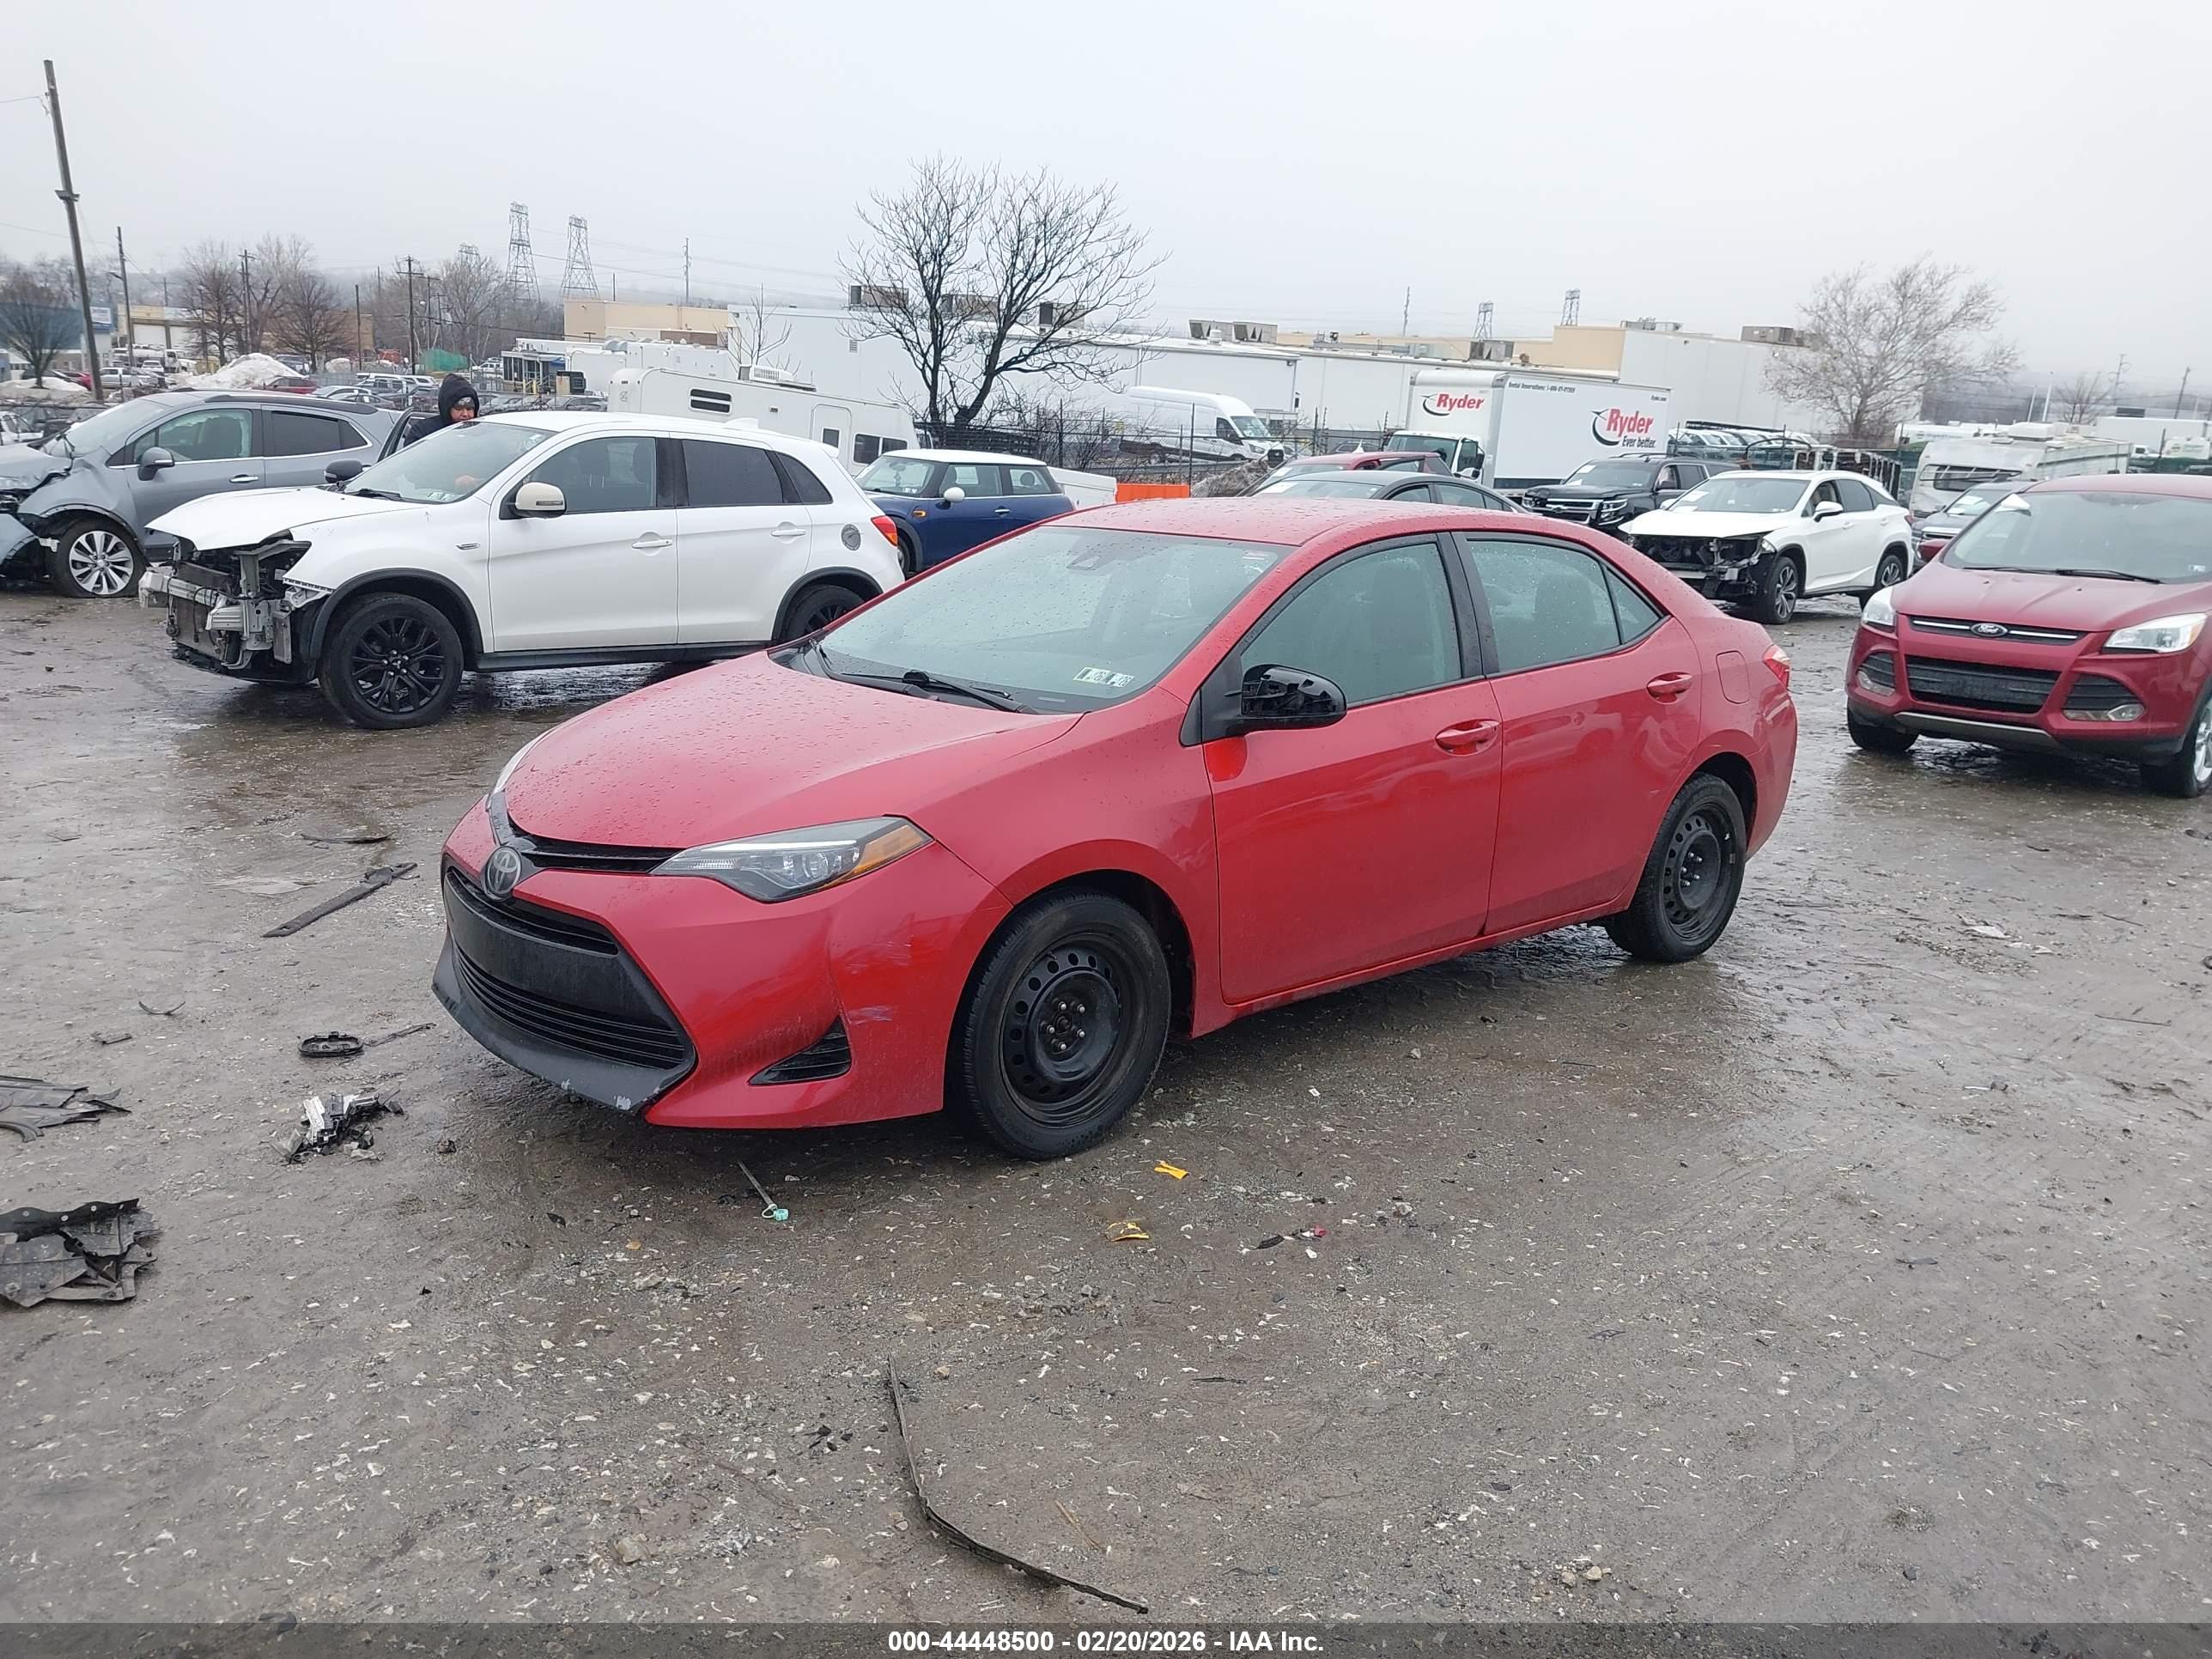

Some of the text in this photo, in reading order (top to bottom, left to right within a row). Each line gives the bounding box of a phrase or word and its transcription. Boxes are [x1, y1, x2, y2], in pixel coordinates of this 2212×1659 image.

[1436, 393, 1485, 411] Ryder
[1606, 408, 1654, 437] Ryder
[1621, 434, 1636, 447] Ever
[1978, 624, 1999, 634] Ford
